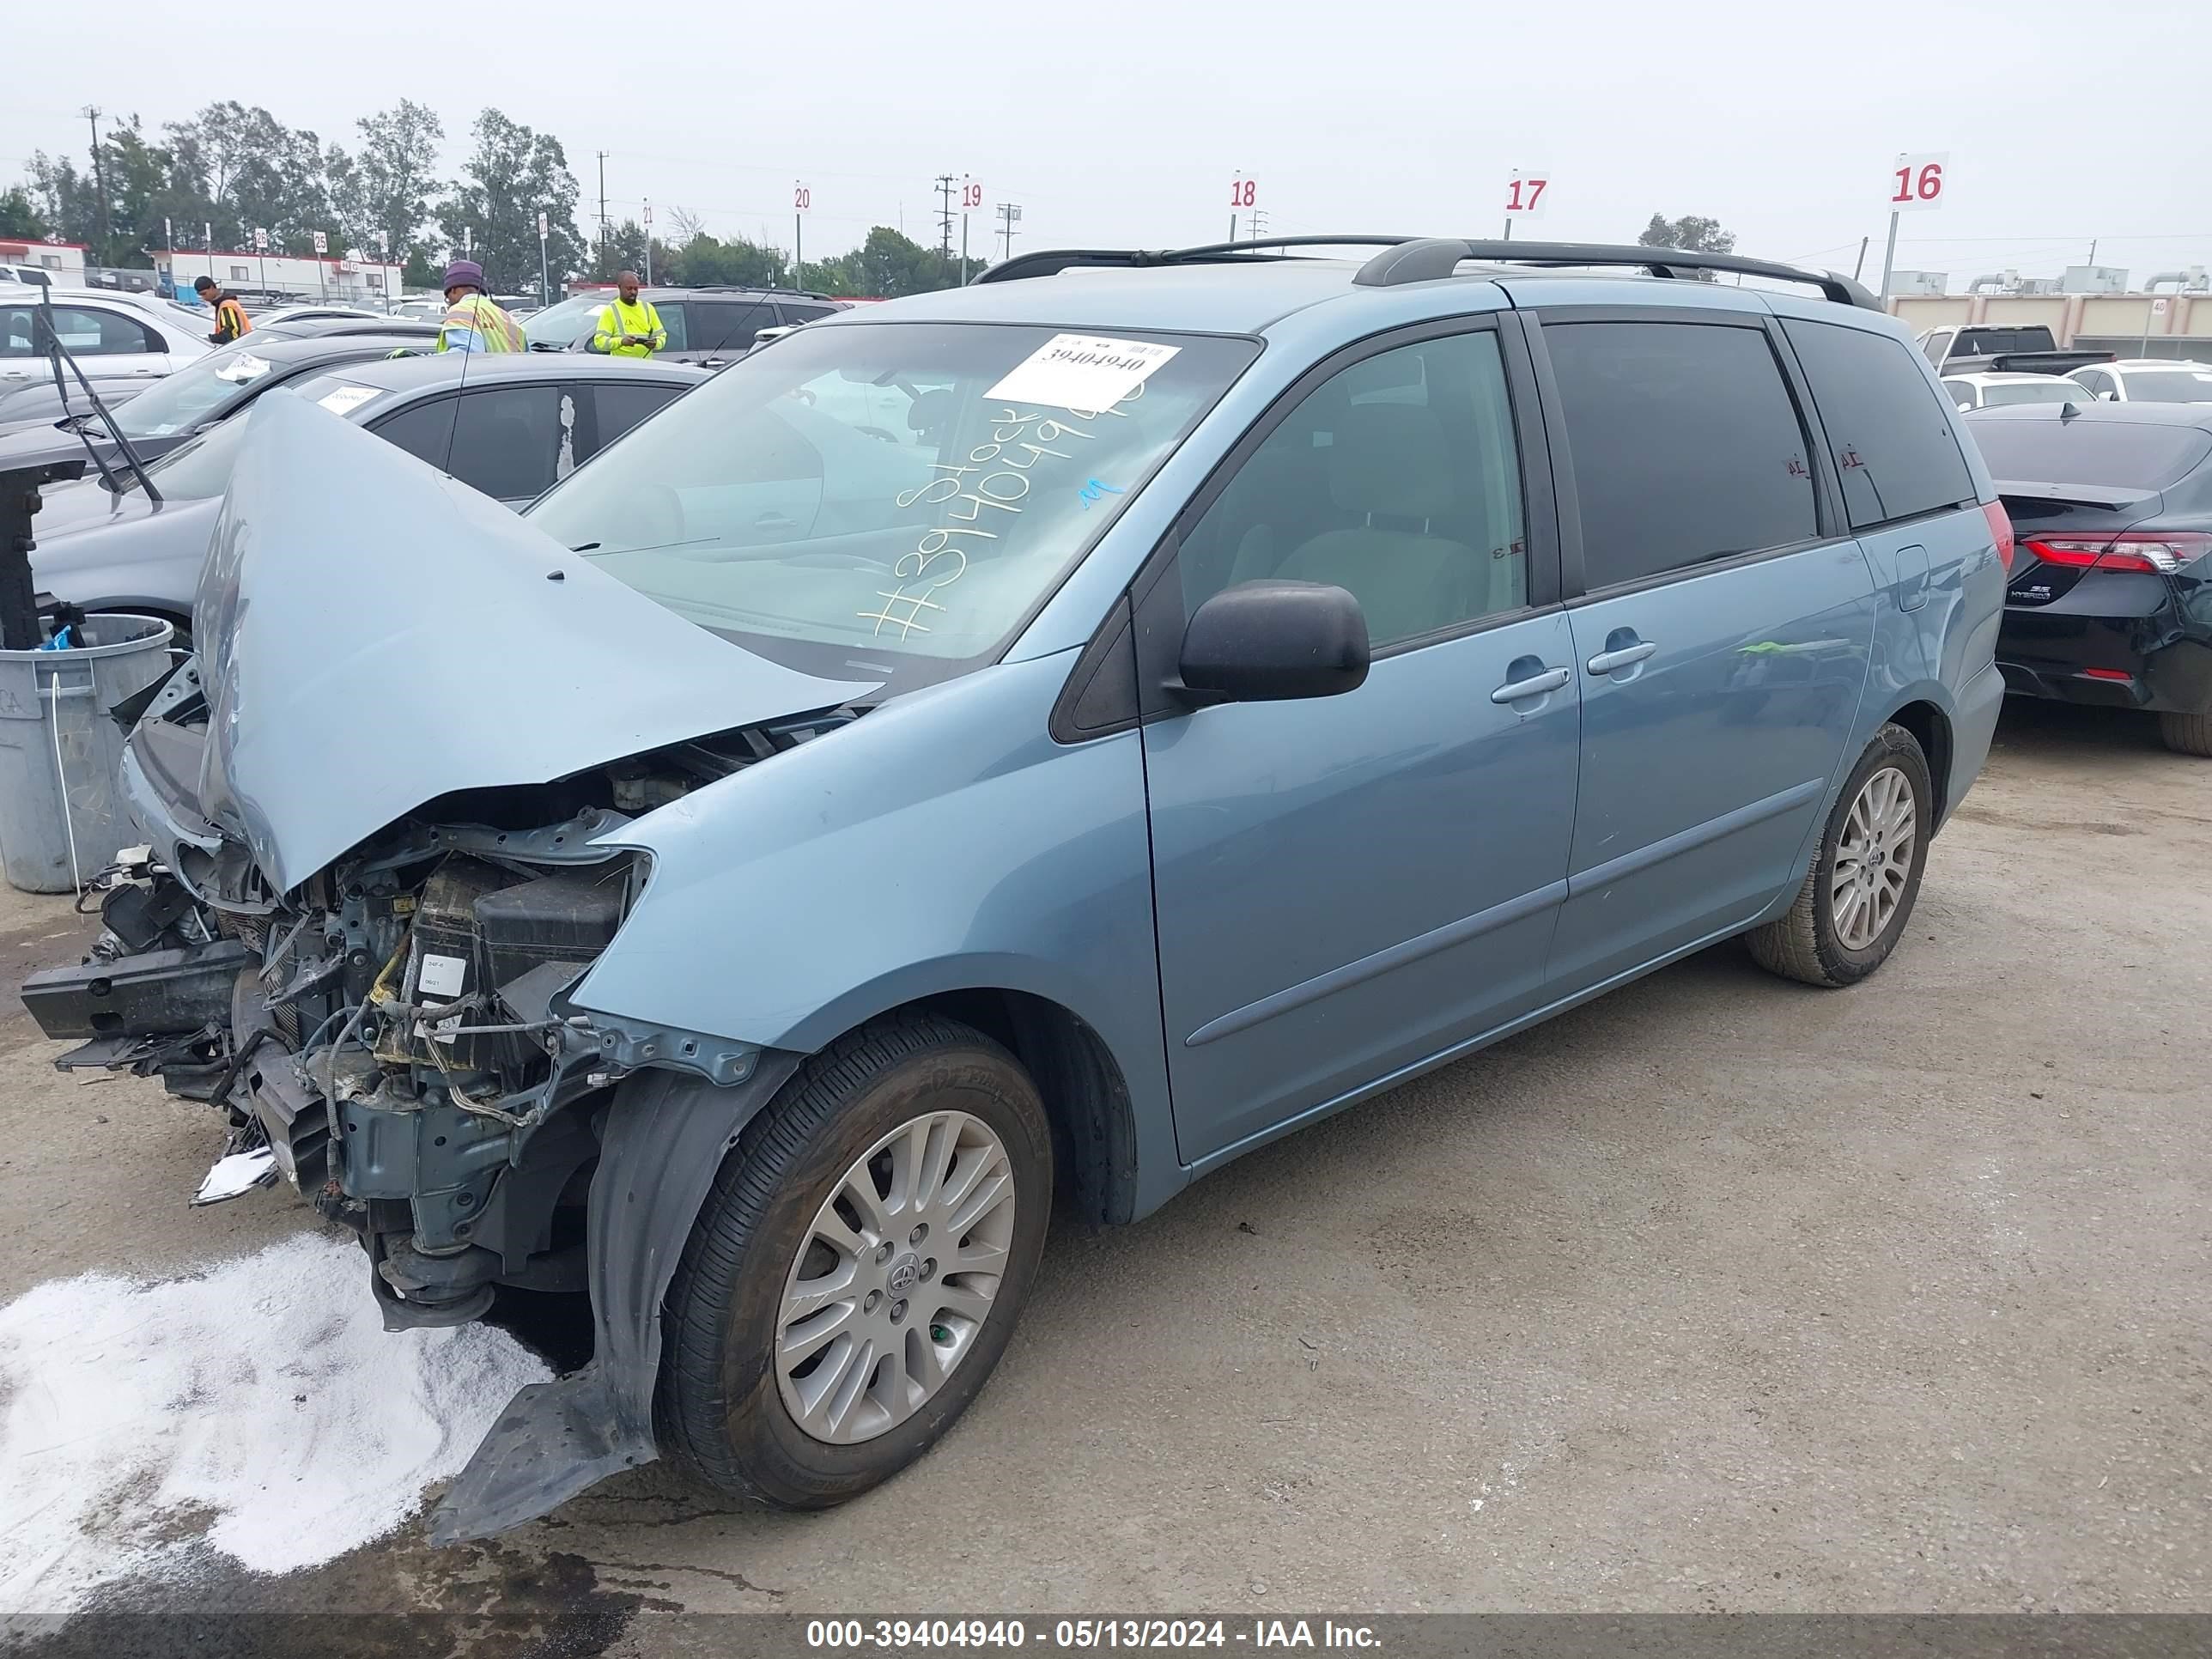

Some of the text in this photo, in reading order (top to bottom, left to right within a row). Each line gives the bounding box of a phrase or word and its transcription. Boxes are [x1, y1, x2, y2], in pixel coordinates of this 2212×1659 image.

[1231, 179, 1255, 207] 18
[1892, 163, 1942, 203] 16
[795, 188, 810, 208] 20
[963, 185, 981, 207] 19
[1505, 179, 1547, 210] 17
[643, 206, 653, 224] 21
[539, 219, 547, 234] 22
[257, 233, 266, 244] 26
[315, 234, 326, 248] 25
[1042, 348, 1146, 371] 39404940
[896, 408, 1042, 508] Stock
